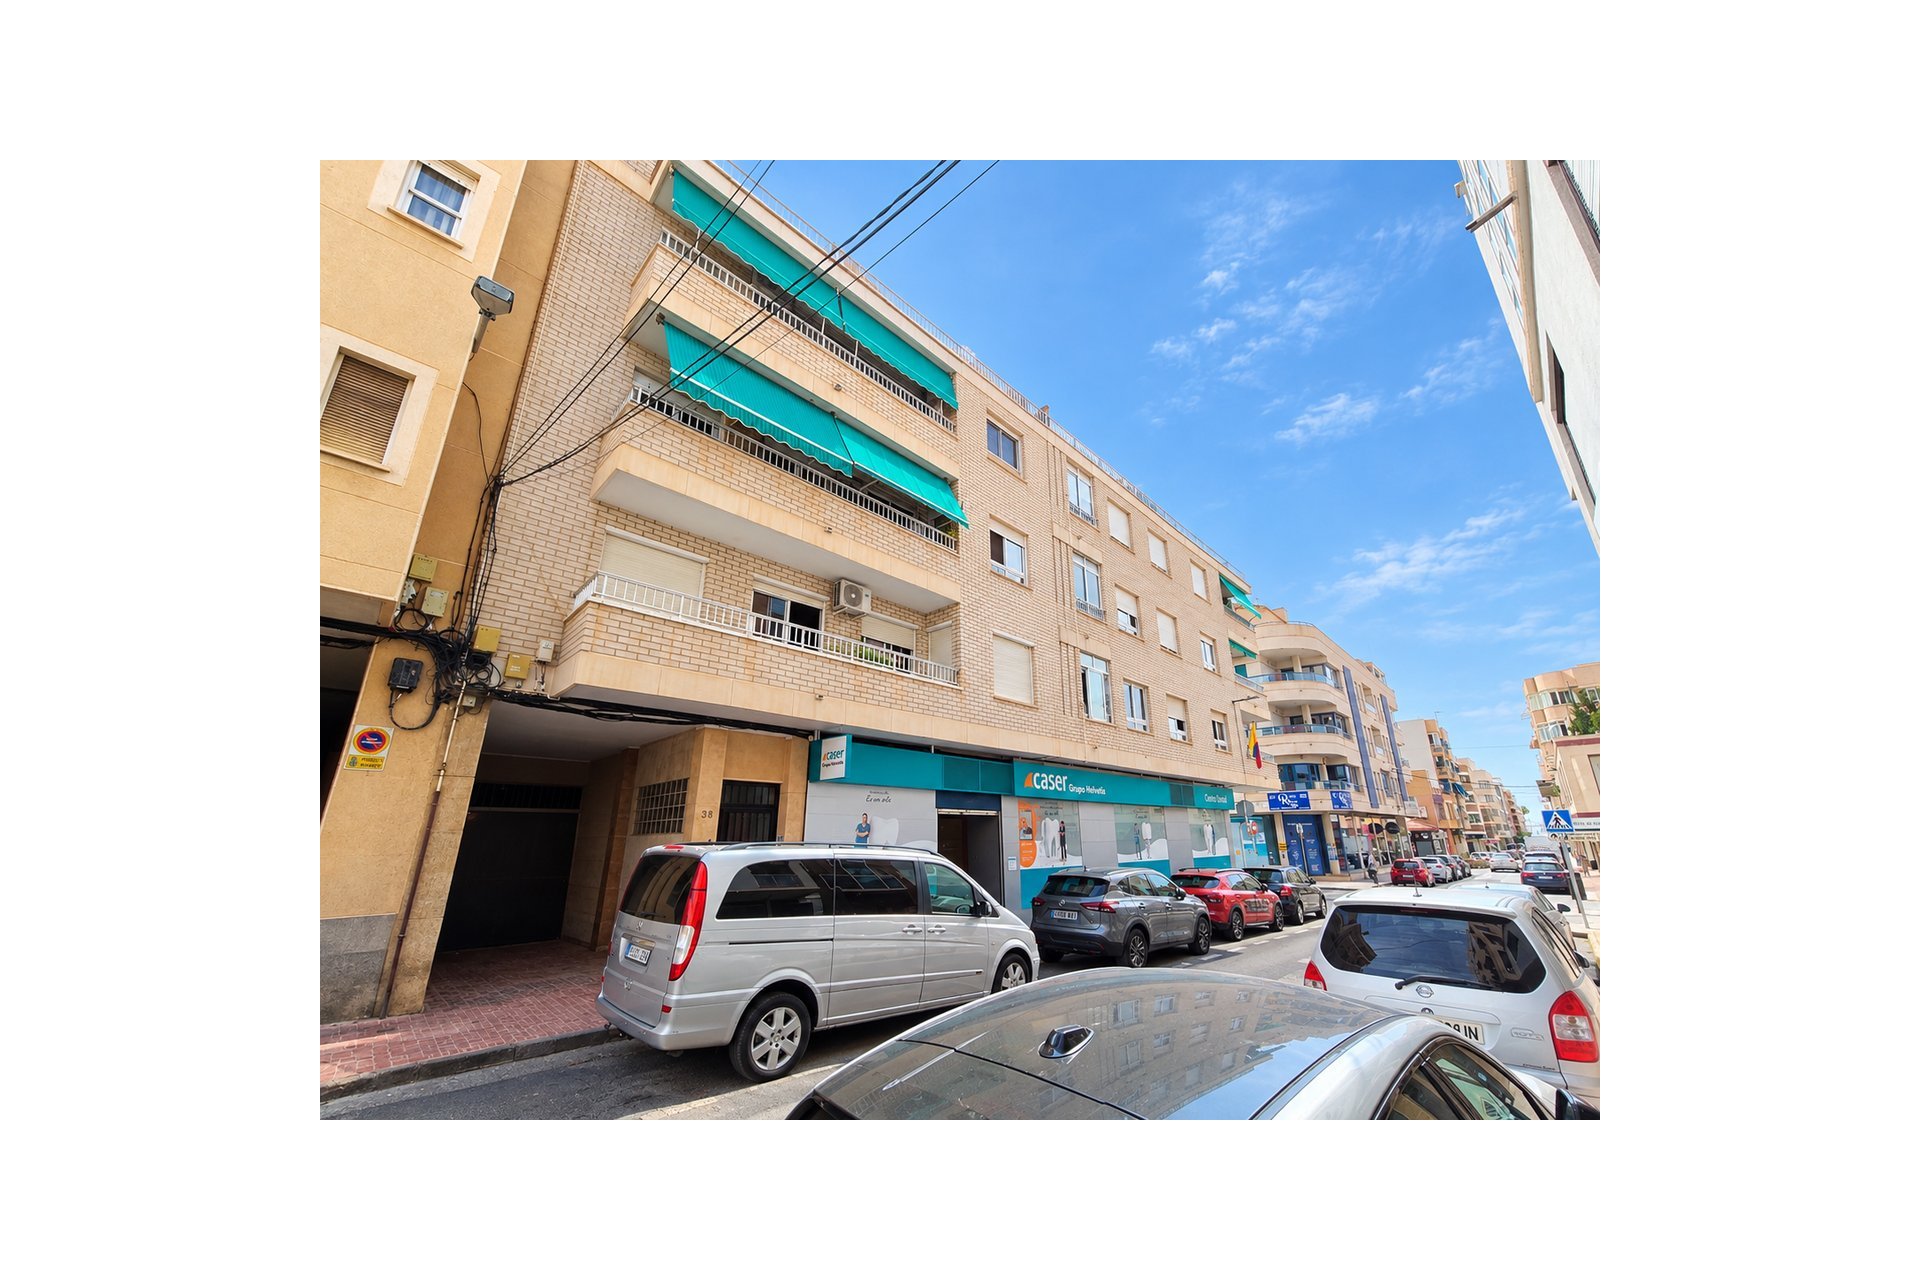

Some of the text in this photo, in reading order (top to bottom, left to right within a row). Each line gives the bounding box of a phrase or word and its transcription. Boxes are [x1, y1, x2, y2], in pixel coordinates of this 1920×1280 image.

[827, 749, 845, 761] caser
[1033, 772, 1068, 792] caser
[1068, 783, 1106, 795] Grupo Helvetia
[701, 810, 713, 819] 38
[1463, 1025, 1479, 1041] IN
